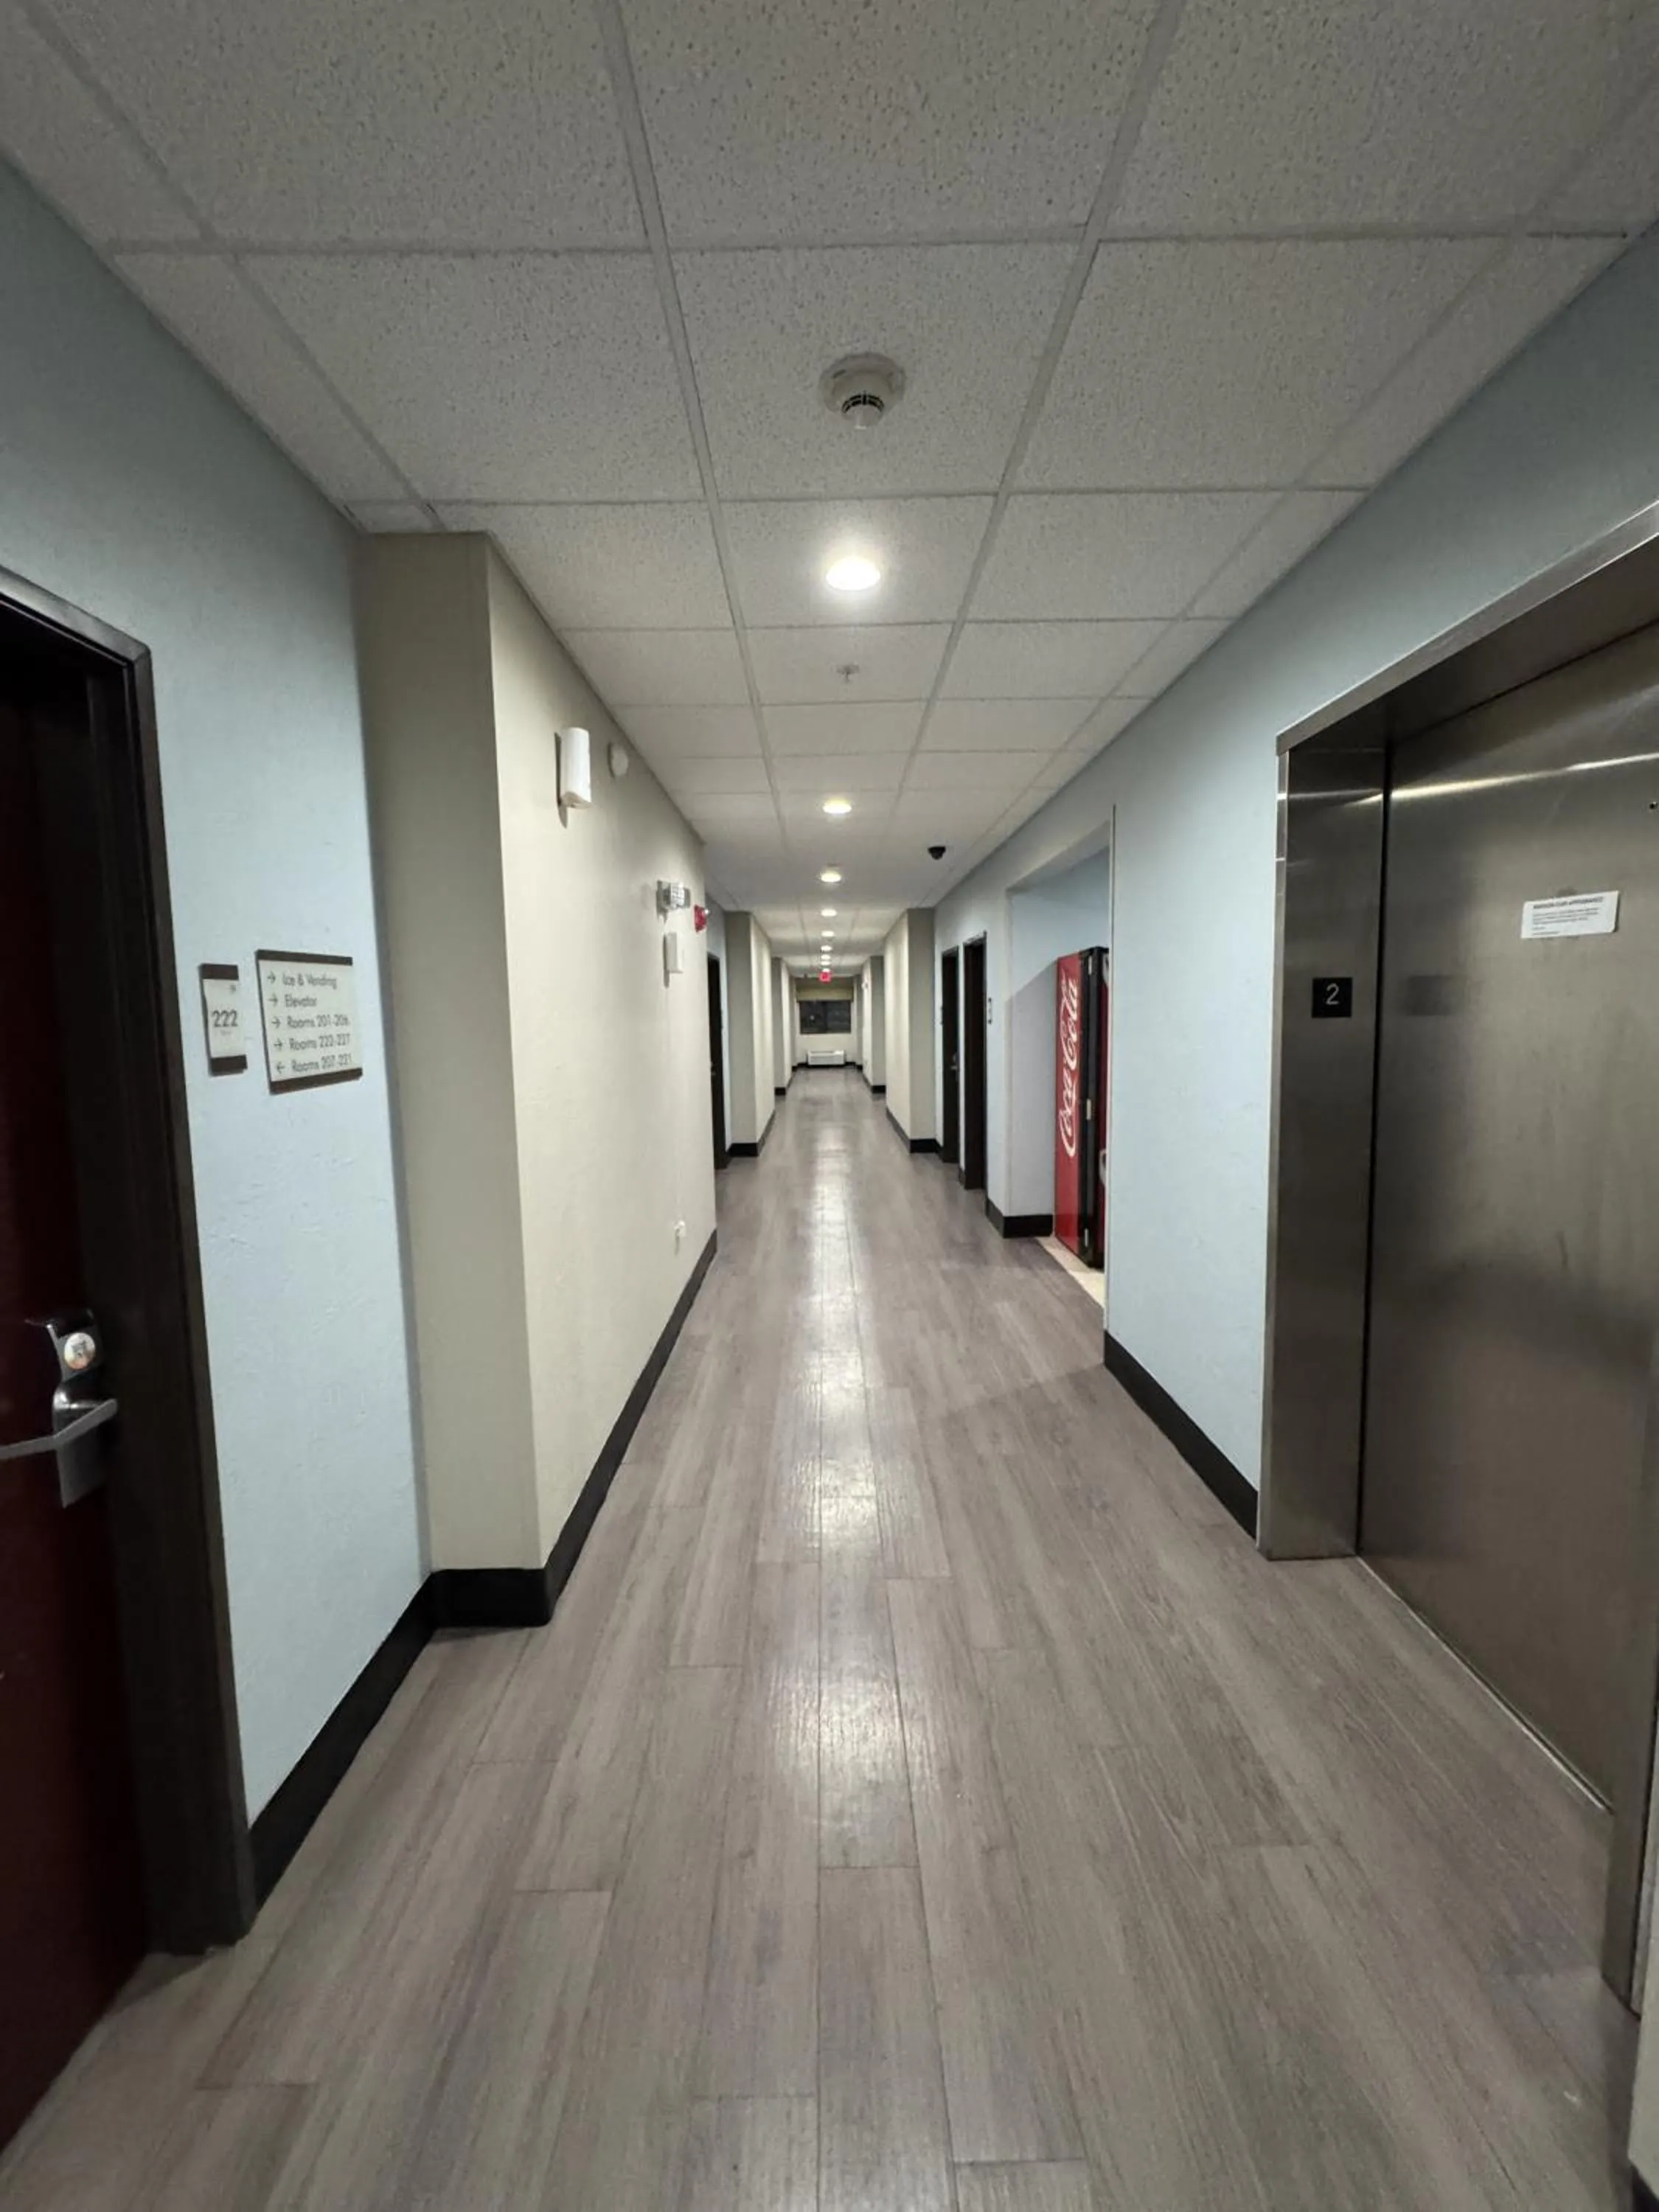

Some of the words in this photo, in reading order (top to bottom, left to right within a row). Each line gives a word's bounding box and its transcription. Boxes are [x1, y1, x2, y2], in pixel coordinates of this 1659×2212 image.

[283, 974, 295, 987] Ice
[297, 973, 305, 987] &
[305, 973, 337, 990] Vending
[285, 994, 317, 1007] Elevator
[1326, 982, 1340, 1006] 2
[212, 1009, 238, 1027] 222
[288, 1015, 316, 1028] Rooms
[289, 1038, 317, 1051] Rooms
[292, 1059, 319, 1072] Rooms
